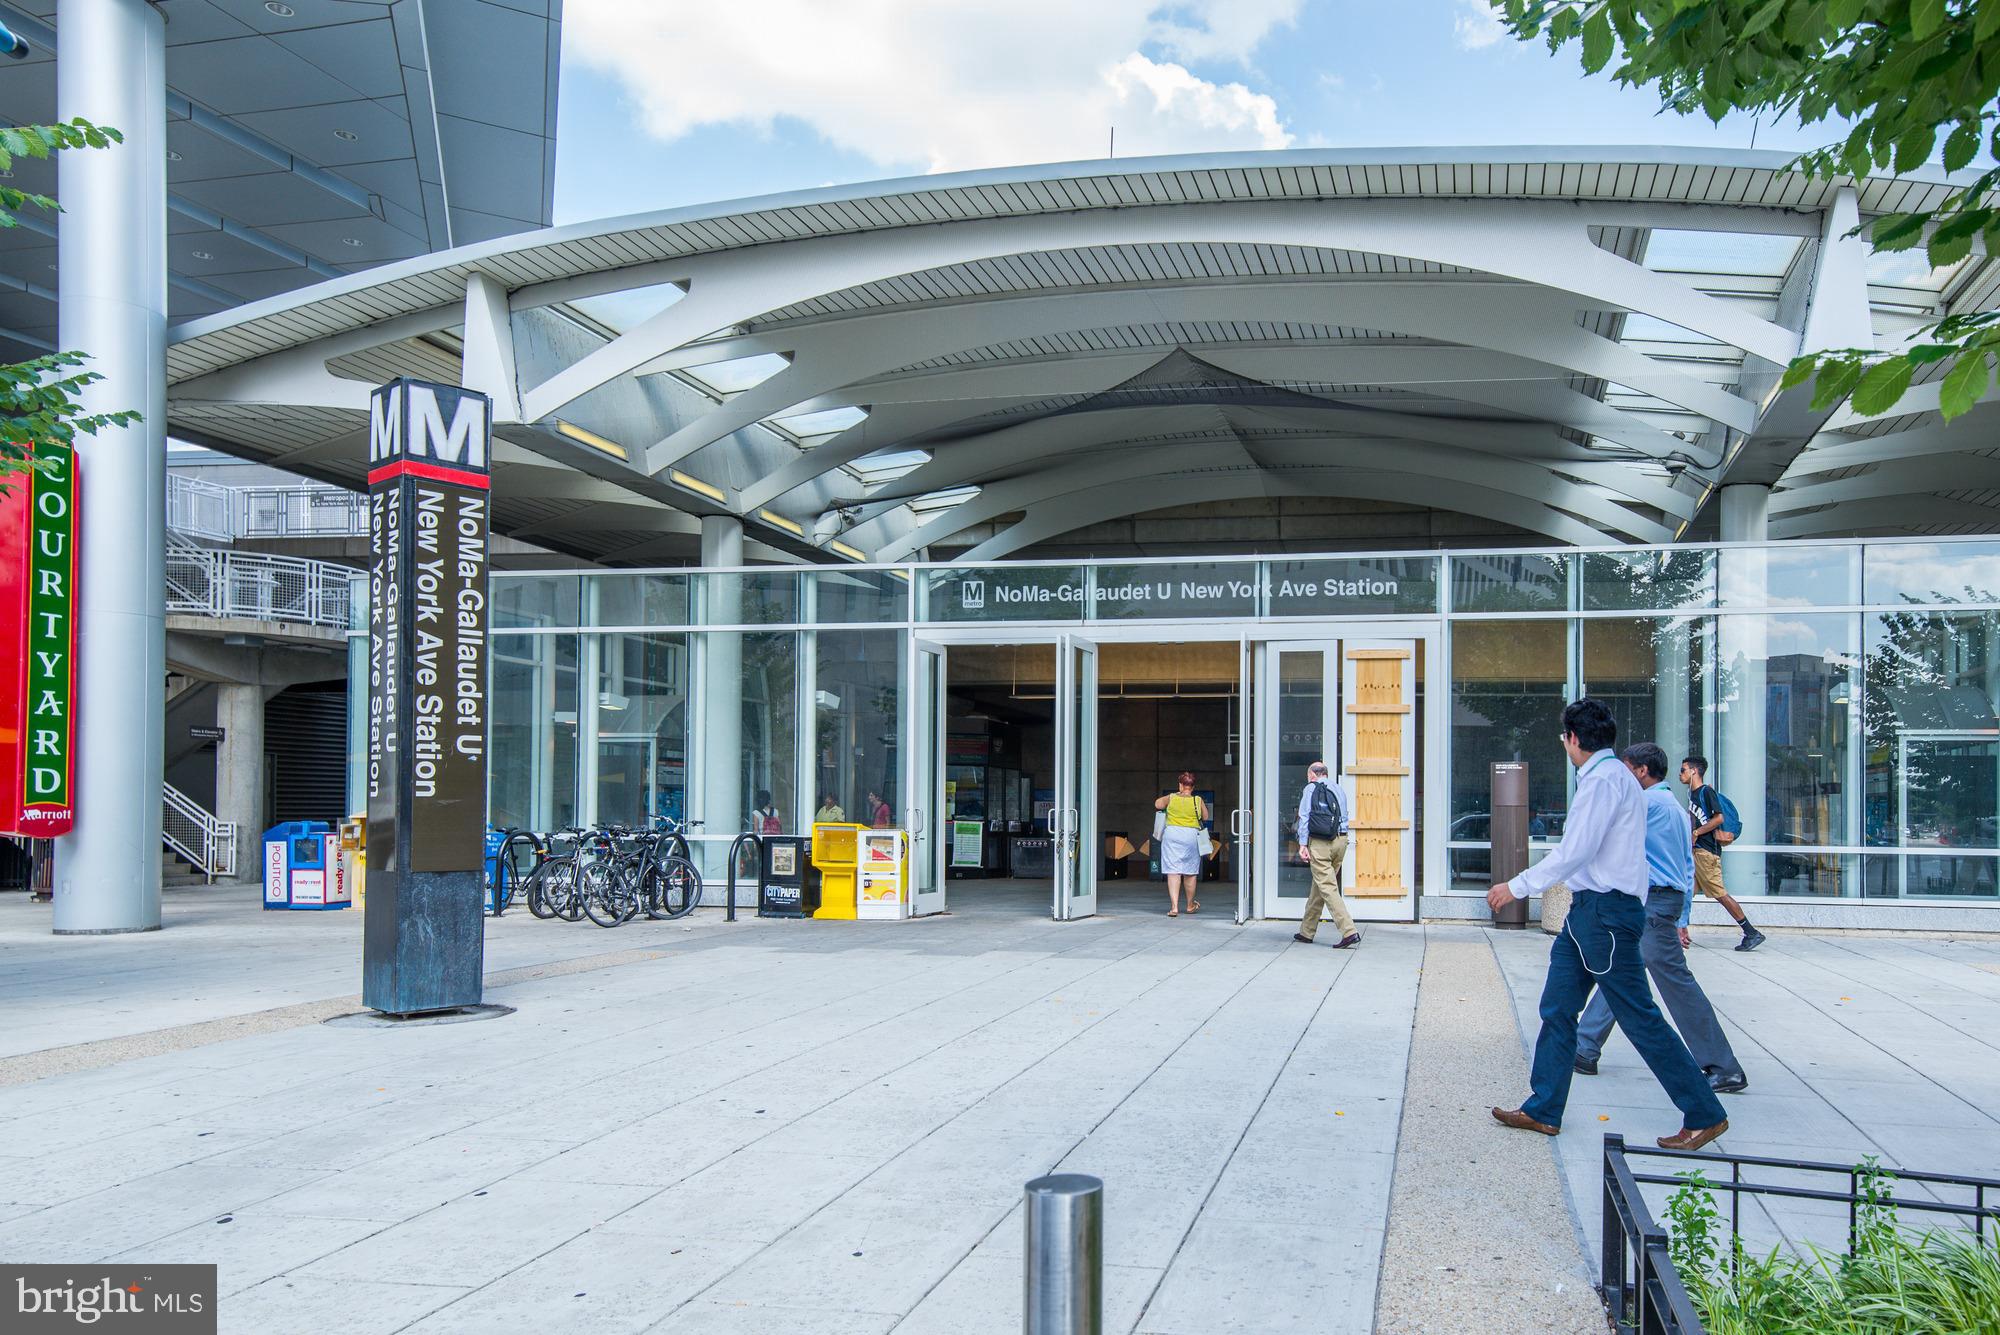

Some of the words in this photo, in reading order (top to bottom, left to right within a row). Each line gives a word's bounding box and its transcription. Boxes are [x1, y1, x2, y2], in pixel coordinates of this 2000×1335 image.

[370, 385, 400, 463] M
[407, 384, 485, 467] M
[373, 493, 384, 554] New
[417, 489, 444, 554] New
[372, 560, 383, 625] York
[386, 488, 400, 723] NoMa-Gallaudet
[417, 559, 444, 623] York
[457, 496, 484, 726] NoMa-Gallaudet
[1157, 583, 1171, 599] U
[1181, 582, 1224, 599] New
[1227, 581, 1272, 598] York
[1278, 580, 1318, 597] Ave
[1323, 578, 1398, 597] Station
[33, 456, 65, 794] COURTYARD
[371, 633, 382, 687] Ave
[416, 632, 443, 686] Ave
[370, 695, 382, 798] Station
[386, 732, 397, 753] U
[415, 694, 443, 798] Station
[457, 735, 482, 755] U
[20, 809, 71, 820] Marriott
[272, 845, 281, 897] POLITICO
